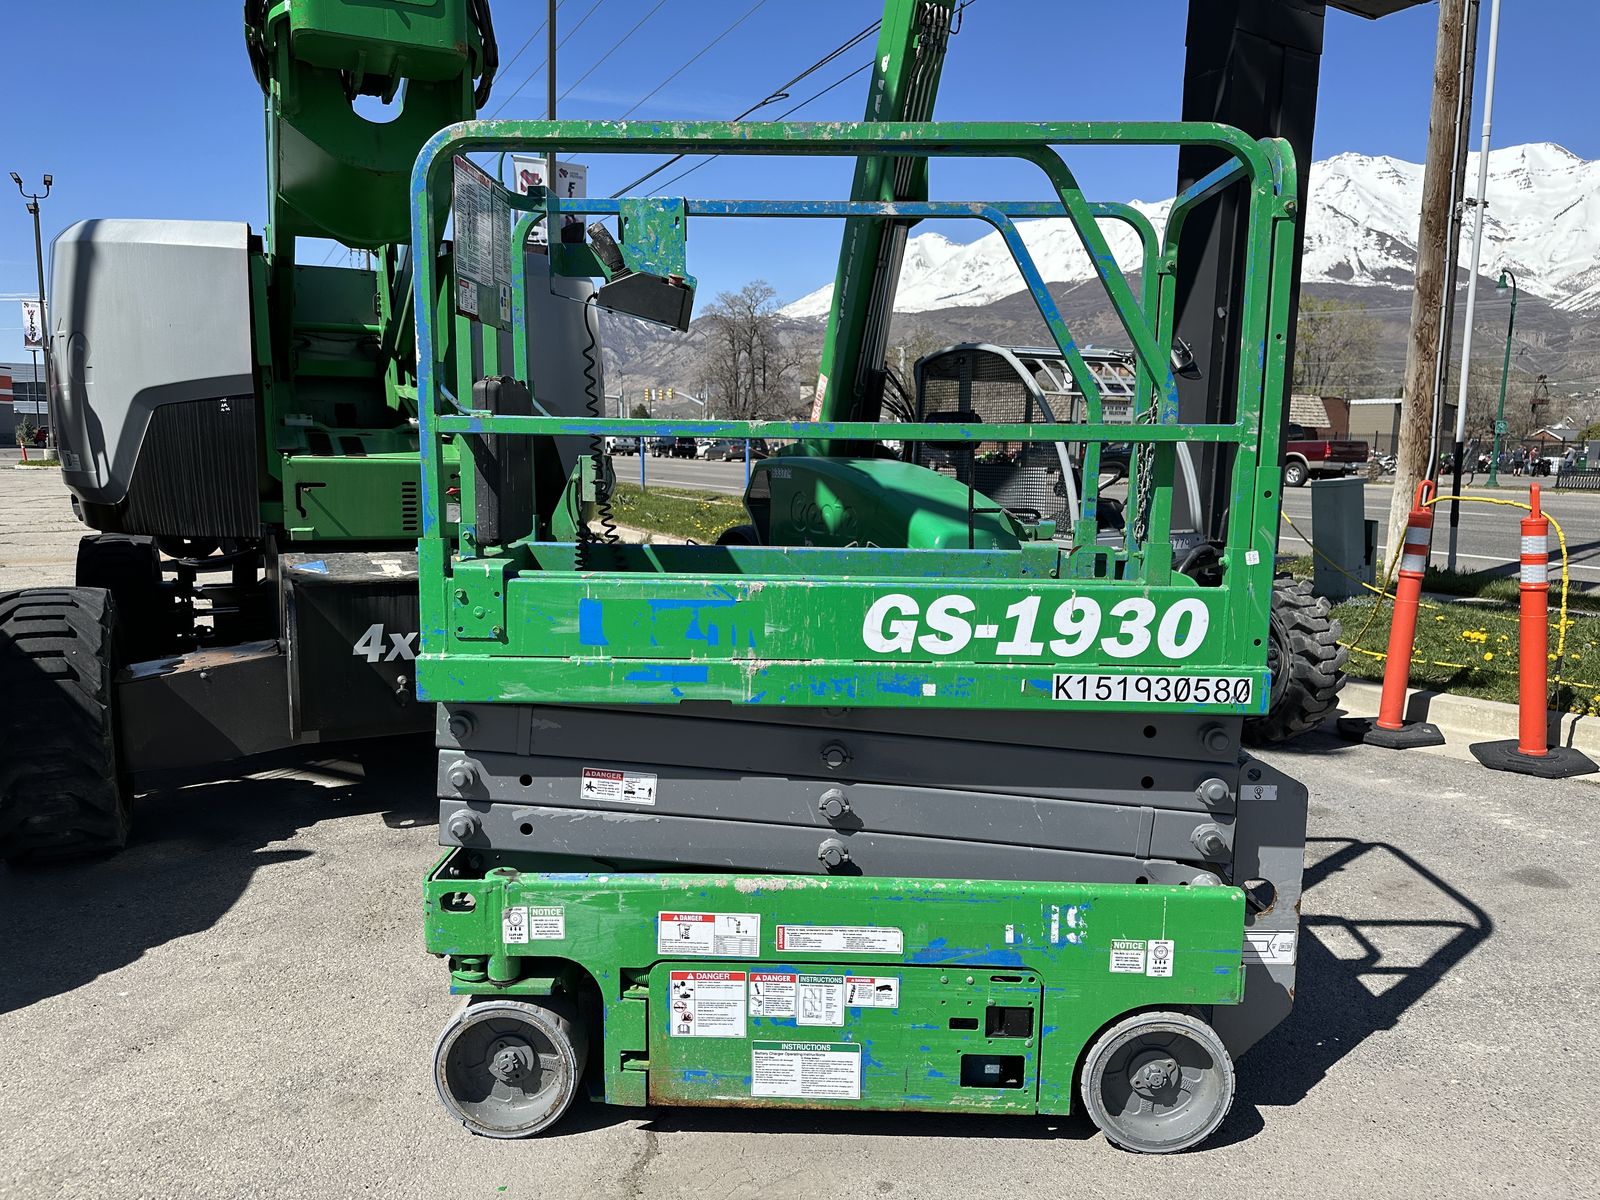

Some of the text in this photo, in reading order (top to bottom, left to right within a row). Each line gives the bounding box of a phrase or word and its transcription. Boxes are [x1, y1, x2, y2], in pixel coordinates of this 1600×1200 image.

[862, 594, 1210, 659] GS-1930
[352, 623, 420, 663] 4x
[592, 770, 622, 780] DANGER
[1114, 942, 1144, 950] NOTICE
